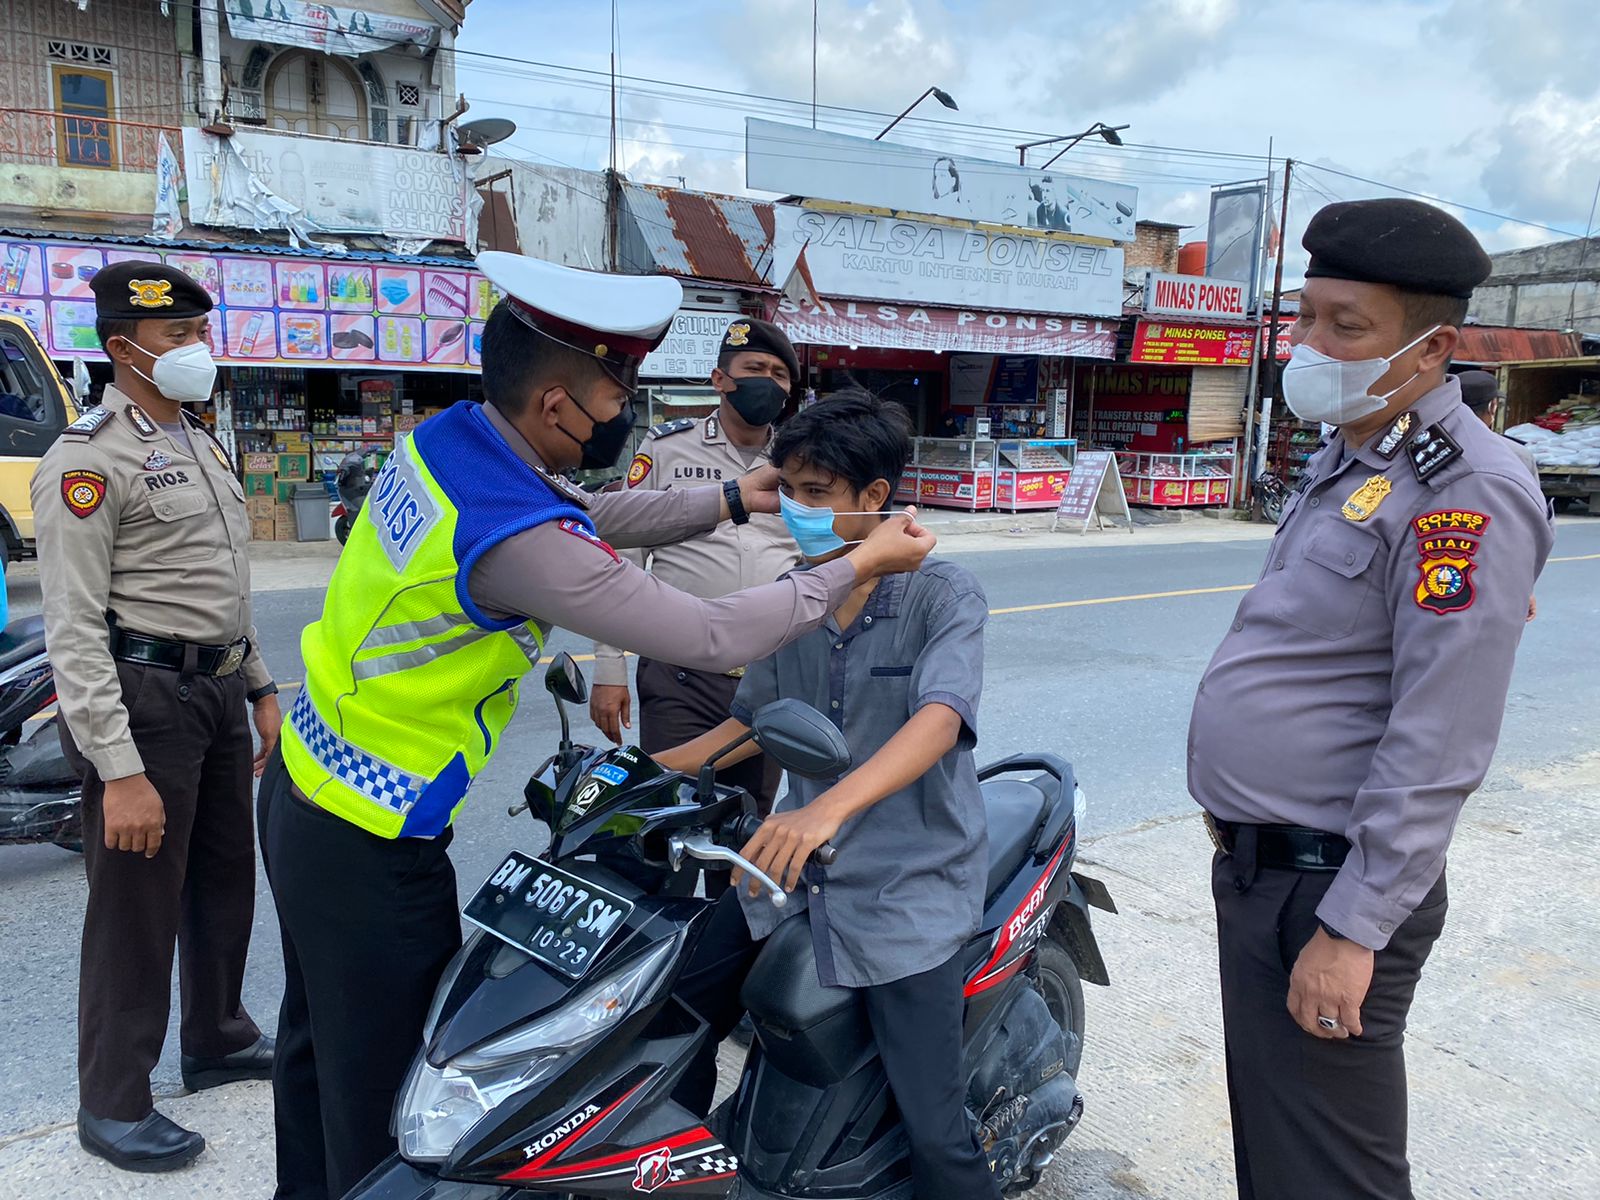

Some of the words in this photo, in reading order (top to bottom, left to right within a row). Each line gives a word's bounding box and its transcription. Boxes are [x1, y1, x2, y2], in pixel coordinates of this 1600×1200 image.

[393, 152, 453, 175] TOKO
[389, 190, 464, 217] MINAS
[389, 210, 464, 237] SEHAT
[793, 212, 945, 259] SALSA
[959, 233, 1113, 277] PONSEL
[842, 253, 913, 275] KARTU
[919, 262, 1012, 284] INTERNET
[1016, 271, 1079, 290] MURAH
[1155, 280, 1195, 310] MINAS
[1198, 284, 1243, 313] PONSEL
[777, 297, 931, 323] SALSA
[957, 311, 1110, 334] PONSEL
[1164, 328, 1192, 338] MINAS
[1194, 329, 1227, 340] PONSEL
[665, 359, 687, 374] ES
[693, 360, 716, 375] TE
[145, 471, 189, 491] RIOS
[674, 467, 722, 480] LUBIS
[1417, 512, 1483, 528] POLRES
[1422, 520, 1476, 532] SIAK
[1425, 539, 1471, 550] RIAU
[490, 858, 532, 893] BM
[525, 873, 589, 920] 5067
[577, 899, 622, 938] SM
[523, 1103, 601, 1159] HONDA
